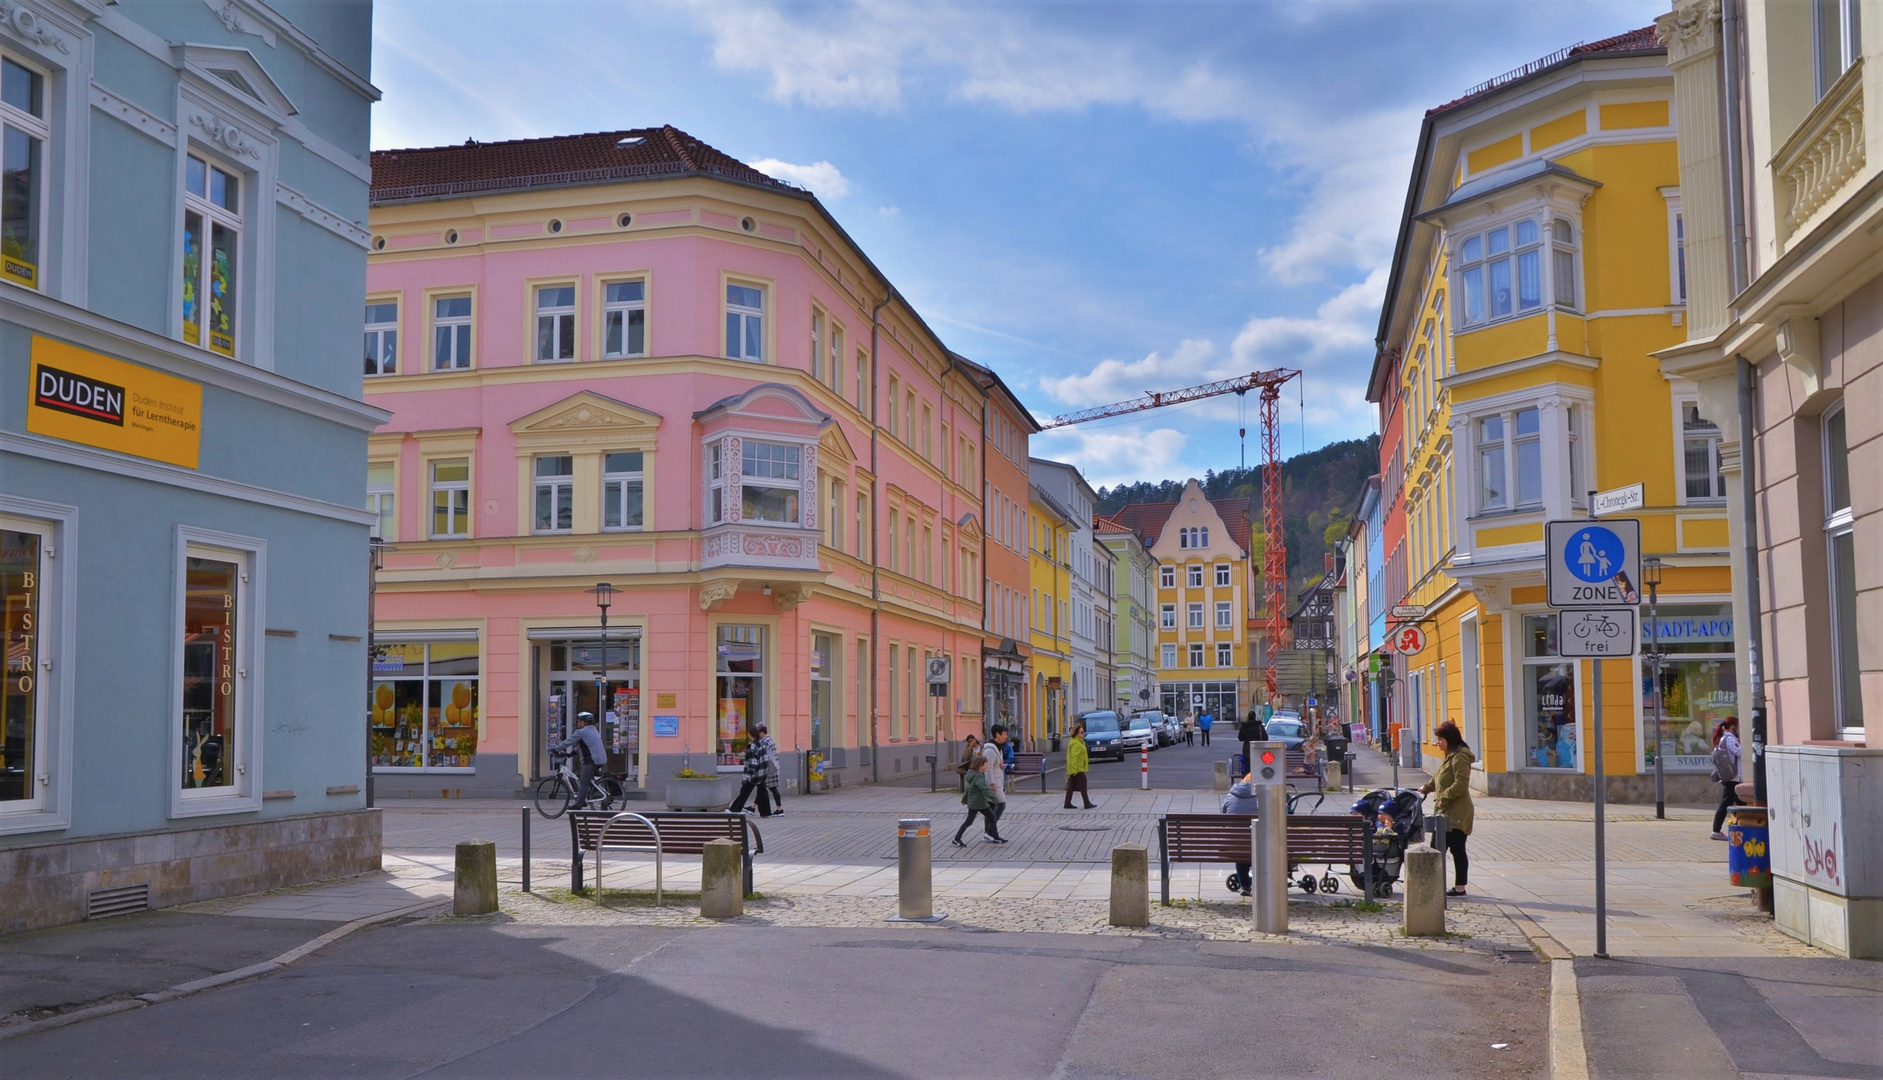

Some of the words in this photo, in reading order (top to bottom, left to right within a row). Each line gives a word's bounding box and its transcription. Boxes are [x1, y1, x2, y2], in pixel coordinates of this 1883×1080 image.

[6, 261, 32, 277] DUDEN
[40, 371, 122, 415] DUDEN
[132, 392, 157, 408] Duden
[159, 399, 184, 416] Institut
[132, 405, 145, 418] für
[146, 409, 196, 432] Lerntherapie
[1572, 586, 1618, 600] ZONE
[18, 571, 35, 693] BISTRO
[1642, 620, 1734, 638] STADT-APO
[221, 594, 233, 696] BISTRO
[1584, 640, 1608, 652] frei
